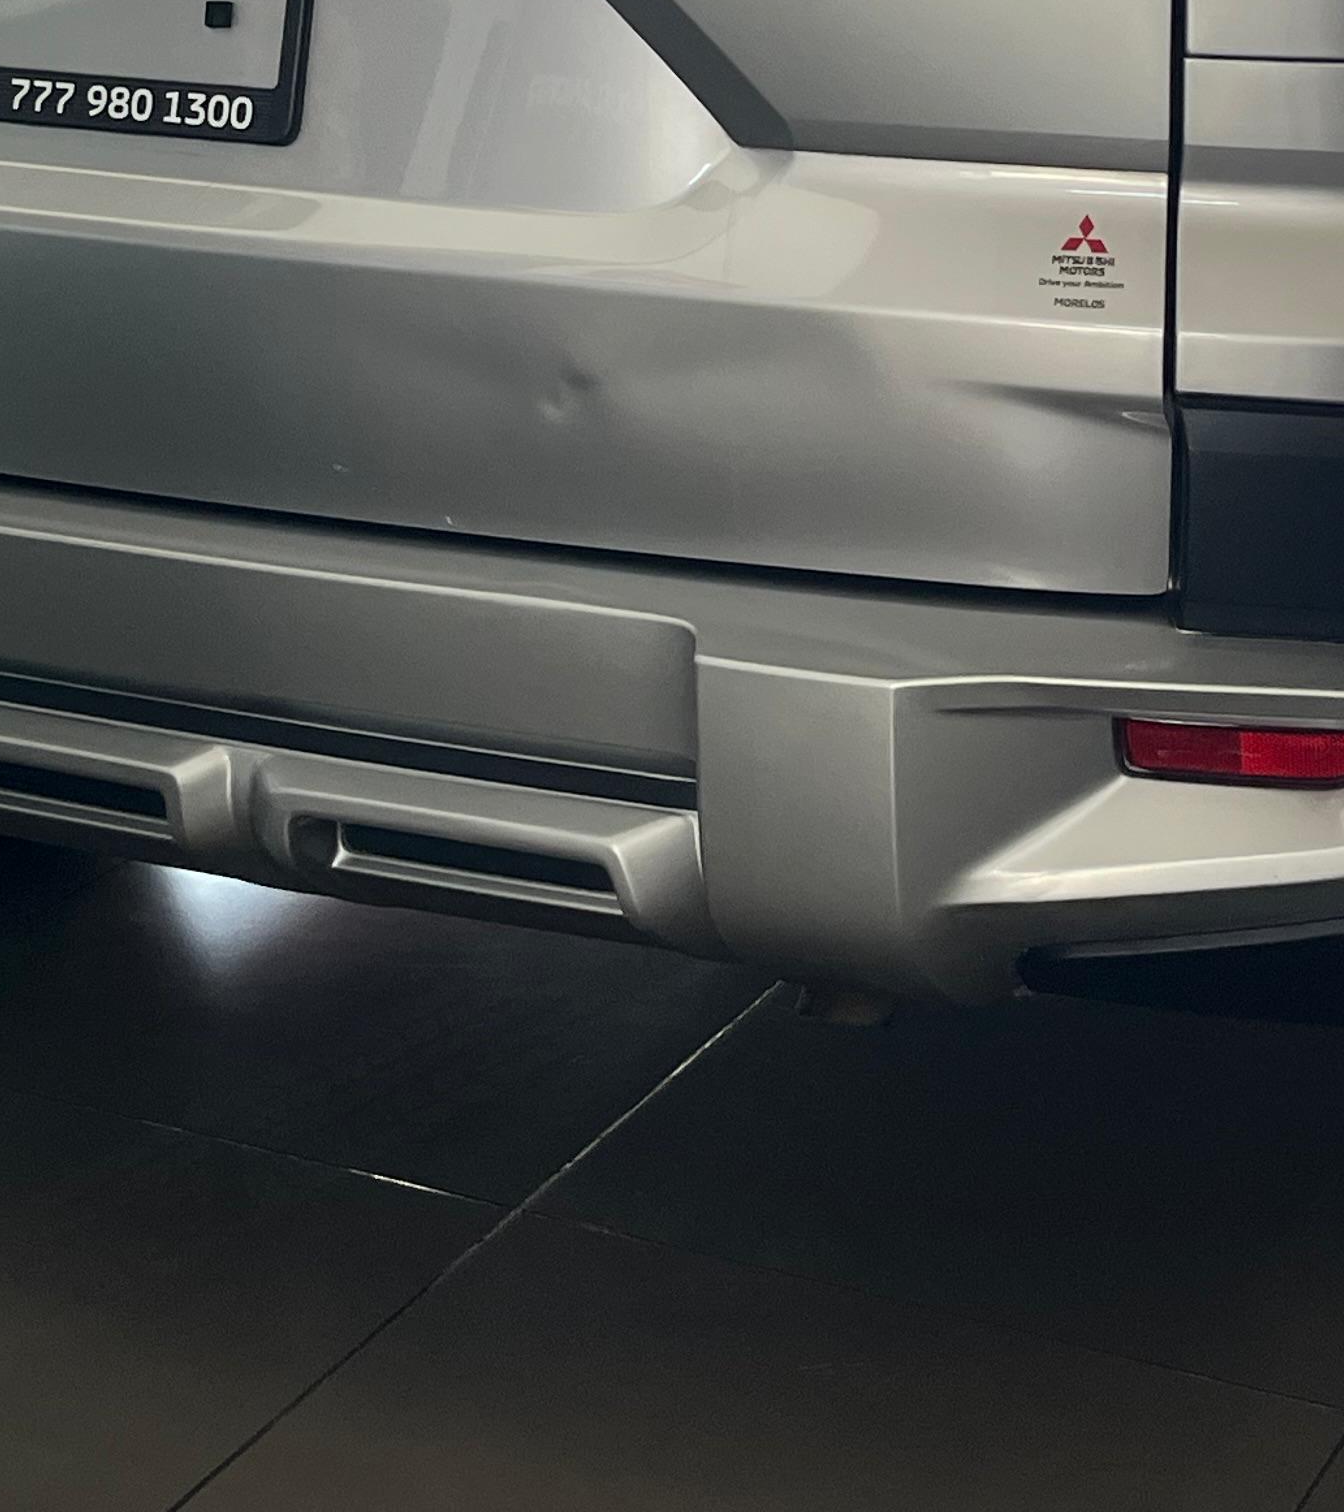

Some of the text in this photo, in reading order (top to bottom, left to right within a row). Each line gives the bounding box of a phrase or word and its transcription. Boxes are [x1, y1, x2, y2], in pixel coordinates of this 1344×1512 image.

[10, 78, 76, 115] 777
[87, 85, 154, 123] 980
[162, 91, 255, 131] 1300
[1059, 266, 1105, 277] MOTORS
[1054, 297, 1105, 309] MORELOS
